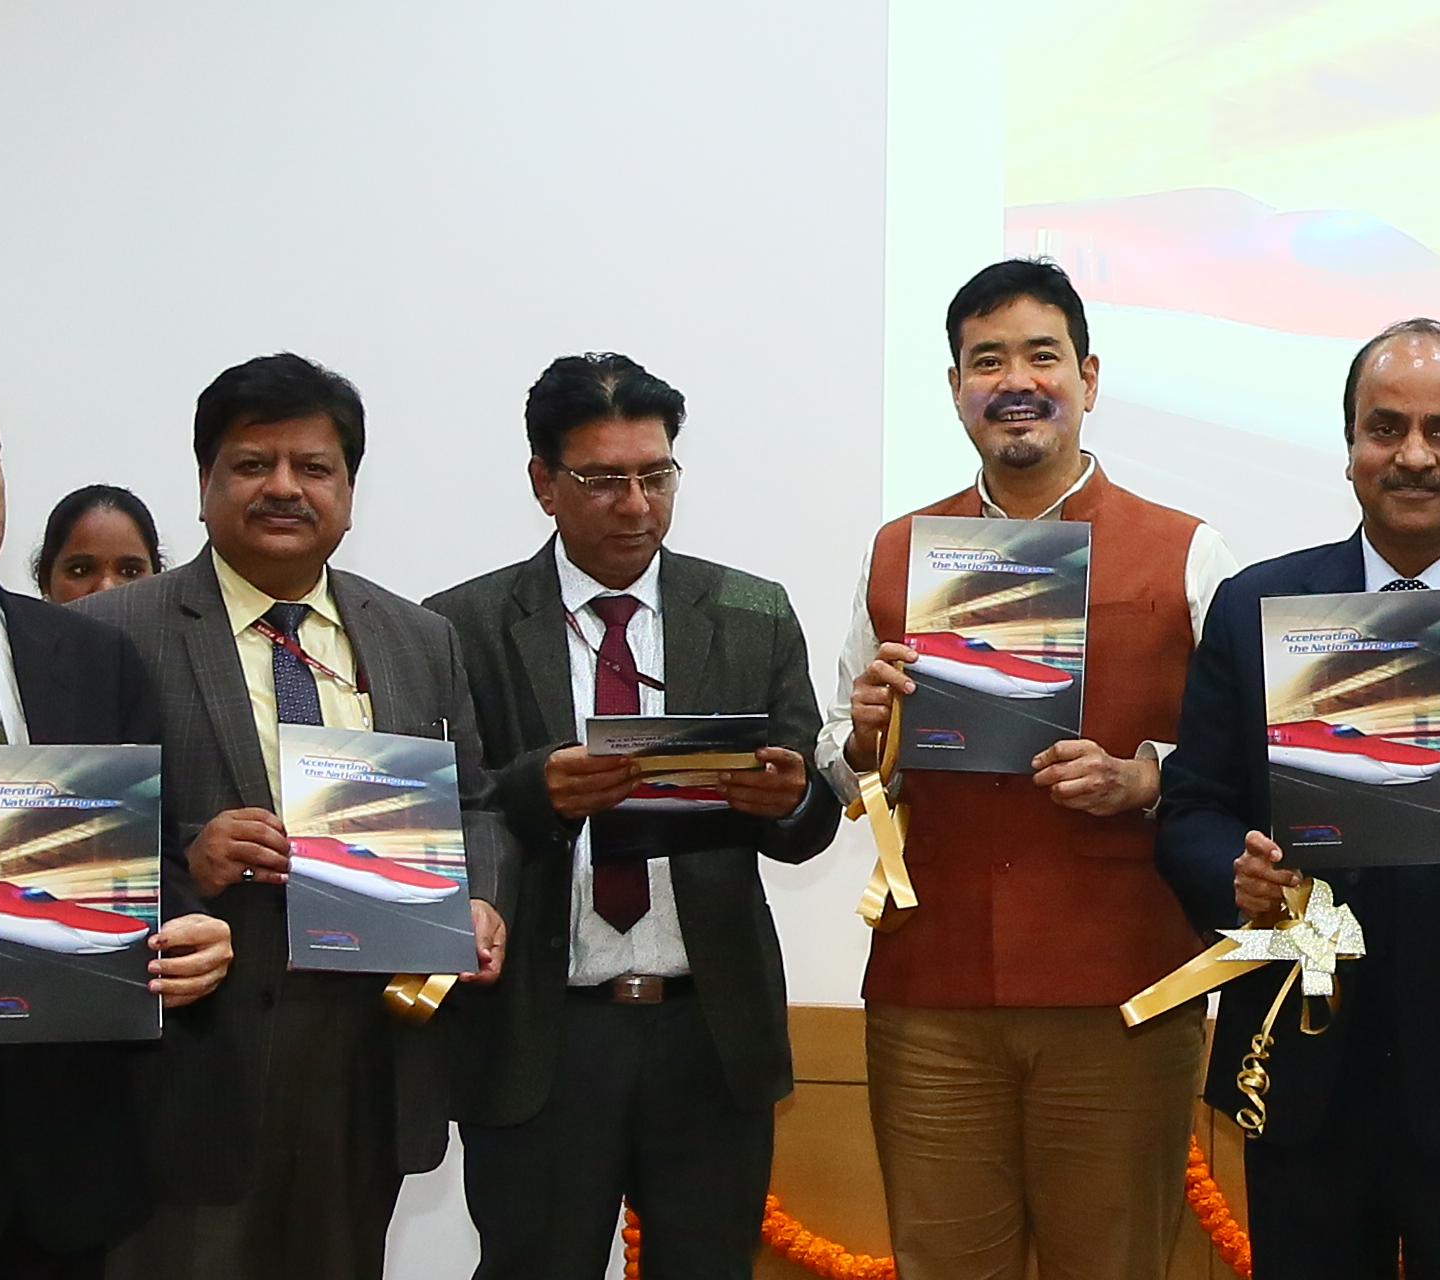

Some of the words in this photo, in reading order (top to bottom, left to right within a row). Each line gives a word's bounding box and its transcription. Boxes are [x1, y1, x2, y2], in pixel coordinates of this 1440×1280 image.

[926, 551, 997, 561] Accelerating
[932, 561, 951, 569] the
[1281, 631, 1357, 642] Accelerating
[1288, 644, 1309, 653] the
[297, 758, 369, 772] Accelerating
[305, 768, 324, 776] the
